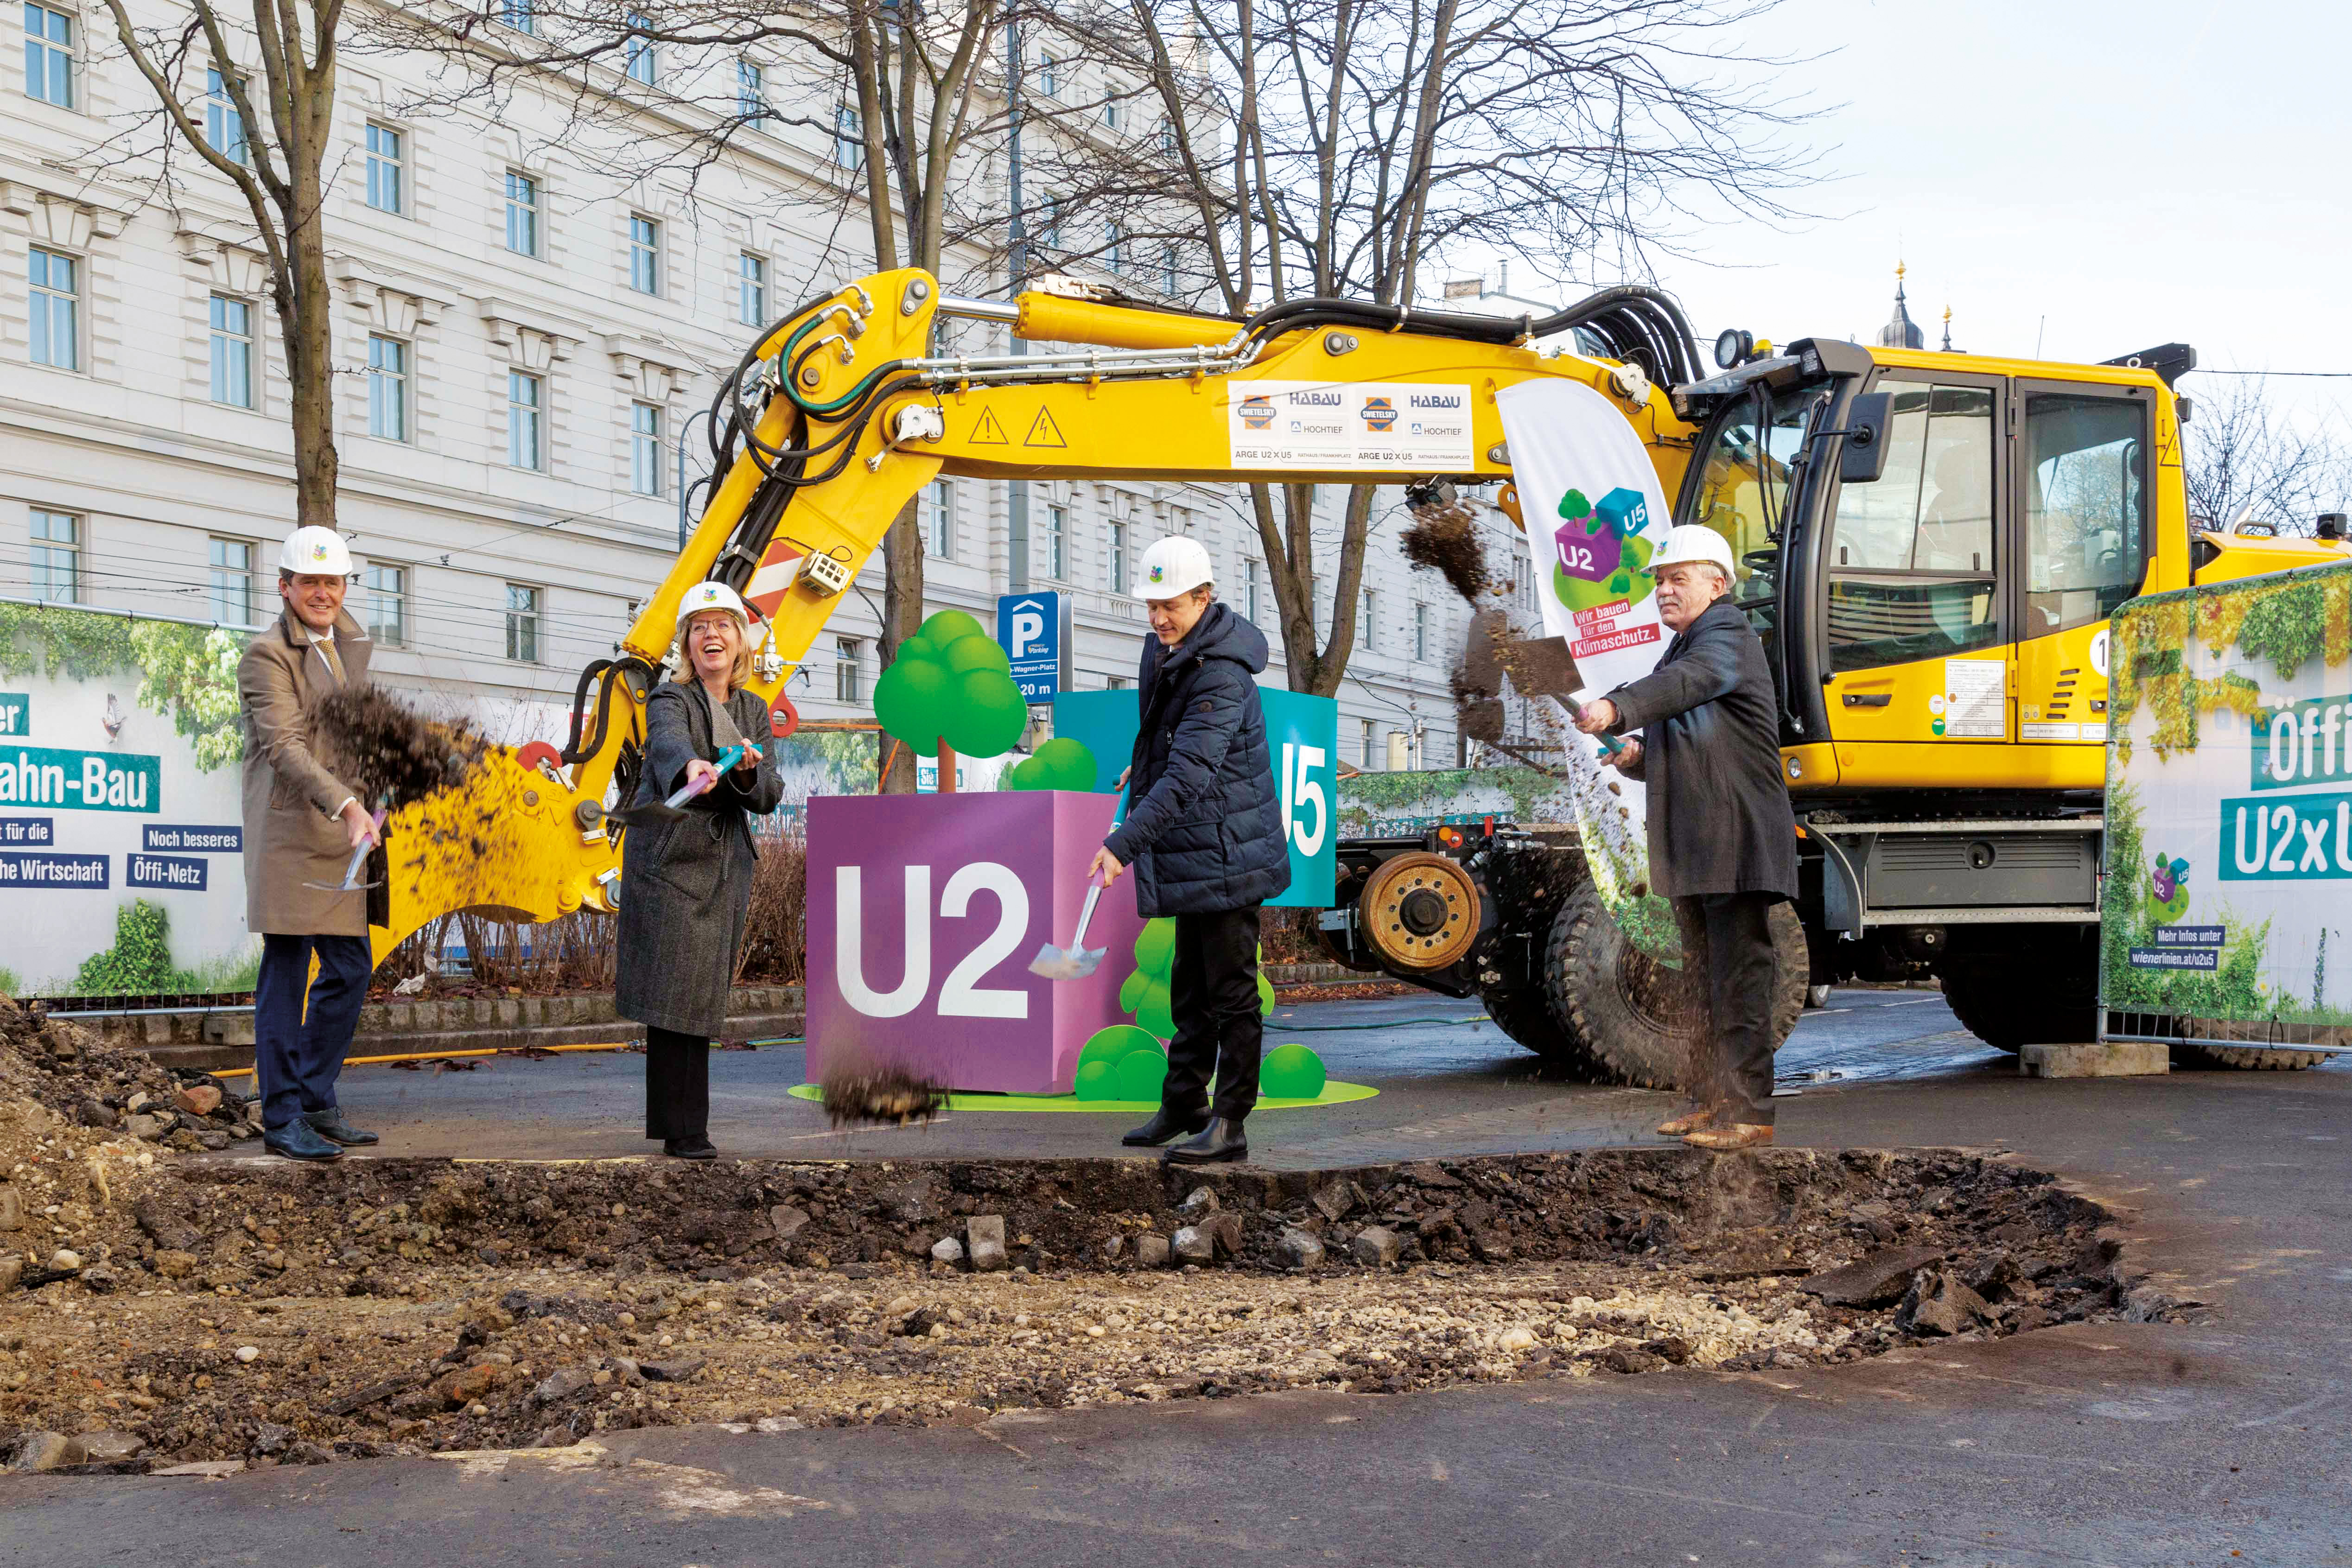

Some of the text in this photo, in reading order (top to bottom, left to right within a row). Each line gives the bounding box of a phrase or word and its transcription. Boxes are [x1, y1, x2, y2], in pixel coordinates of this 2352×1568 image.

[1290, 393, 1341, 406] HABAU
[1411, 395, 1461, 408] HABAU
[1240, 407, 1275, 416] SWIETELSKY
[1362, 409, 1396, 419] SWIETELSKY
[1304, 425, 1342, 435] HOCHTIEF
[1424, 427, 1462, 436] HOCHTIEF
[1624, 502, 1646, 531] U5
[1558, 542, 1595, 571] U2
[1575, 602, 1629, 625] Wir bauen
[1012, 613, 1043, 658] P
[1583, 622, 1613, 636] für den
[1575, 628, 1654, 657] Klimaschutz.
[1039, 685, 1050, 694] m
[2270, 696, 2352, 781] Öffi
[0, 752, 146, 807] ahn-Bau
[6, 823, 25, 840] für
[28, 823, 48, 840] die
[149, 830, 238, 847] Noch besseres
[20, 859, 103, 882] Wirtschaft
[134, 856, 201, 884] Öffi-Netz
[2179, 869, 2188, 882] U5
[2154, 878, 2165, 898] U2
[836, 862, 1030, 1019] U2
[2158, 930, 2221, 942] Mehr Infos unter
[2132, 951, 2214, 966] wienerlinien.at/u2u5
